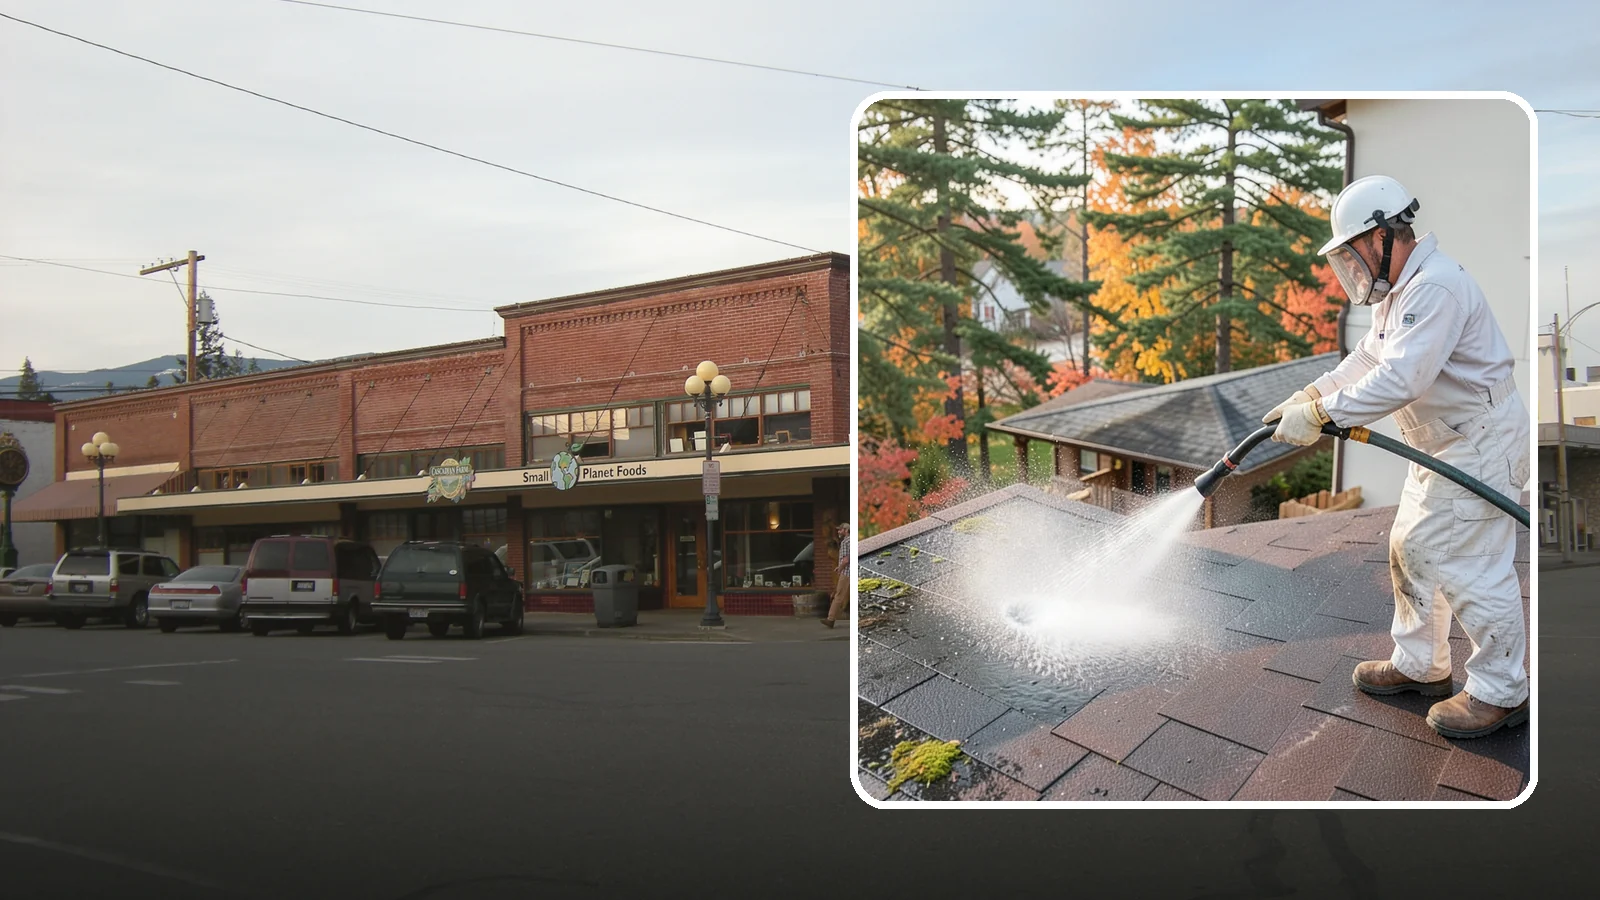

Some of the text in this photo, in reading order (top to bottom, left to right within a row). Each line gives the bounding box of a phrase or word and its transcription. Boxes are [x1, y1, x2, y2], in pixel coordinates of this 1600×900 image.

[523, 464, 647, 482] Small Planet Foods
